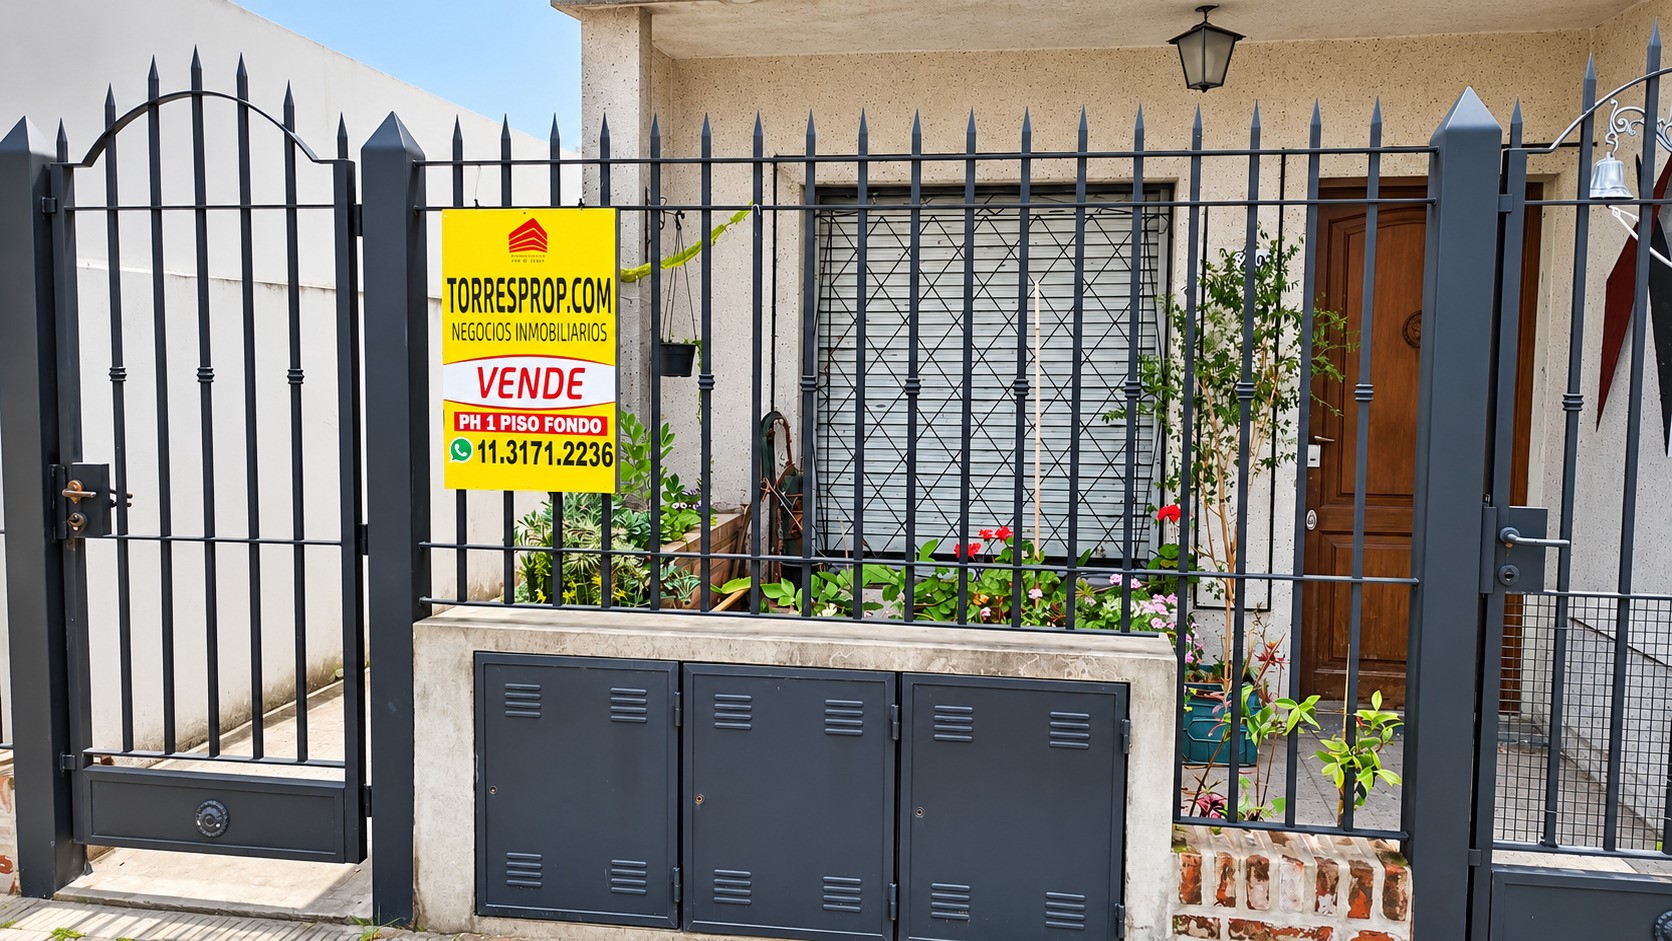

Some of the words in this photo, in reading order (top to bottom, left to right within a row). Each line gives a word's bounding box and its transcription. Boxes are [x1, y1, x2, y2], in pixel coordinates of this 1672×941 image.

[446, 277, 612, 314] TORRESPROP.COM
[452, 322, 512, 342] NEGOCIOS
[516, 322, 607, 342] INMOBILIARIOS
[477, 366, 586, 400] VENDE
[459, 414, 482, 430] PH
[486, 415, 496, 431] 1
[501, 415, 540, 432] PISO
[544, 416, 602, 434] FONDO
[477, 439, 614, 468] 11.3171.2236
